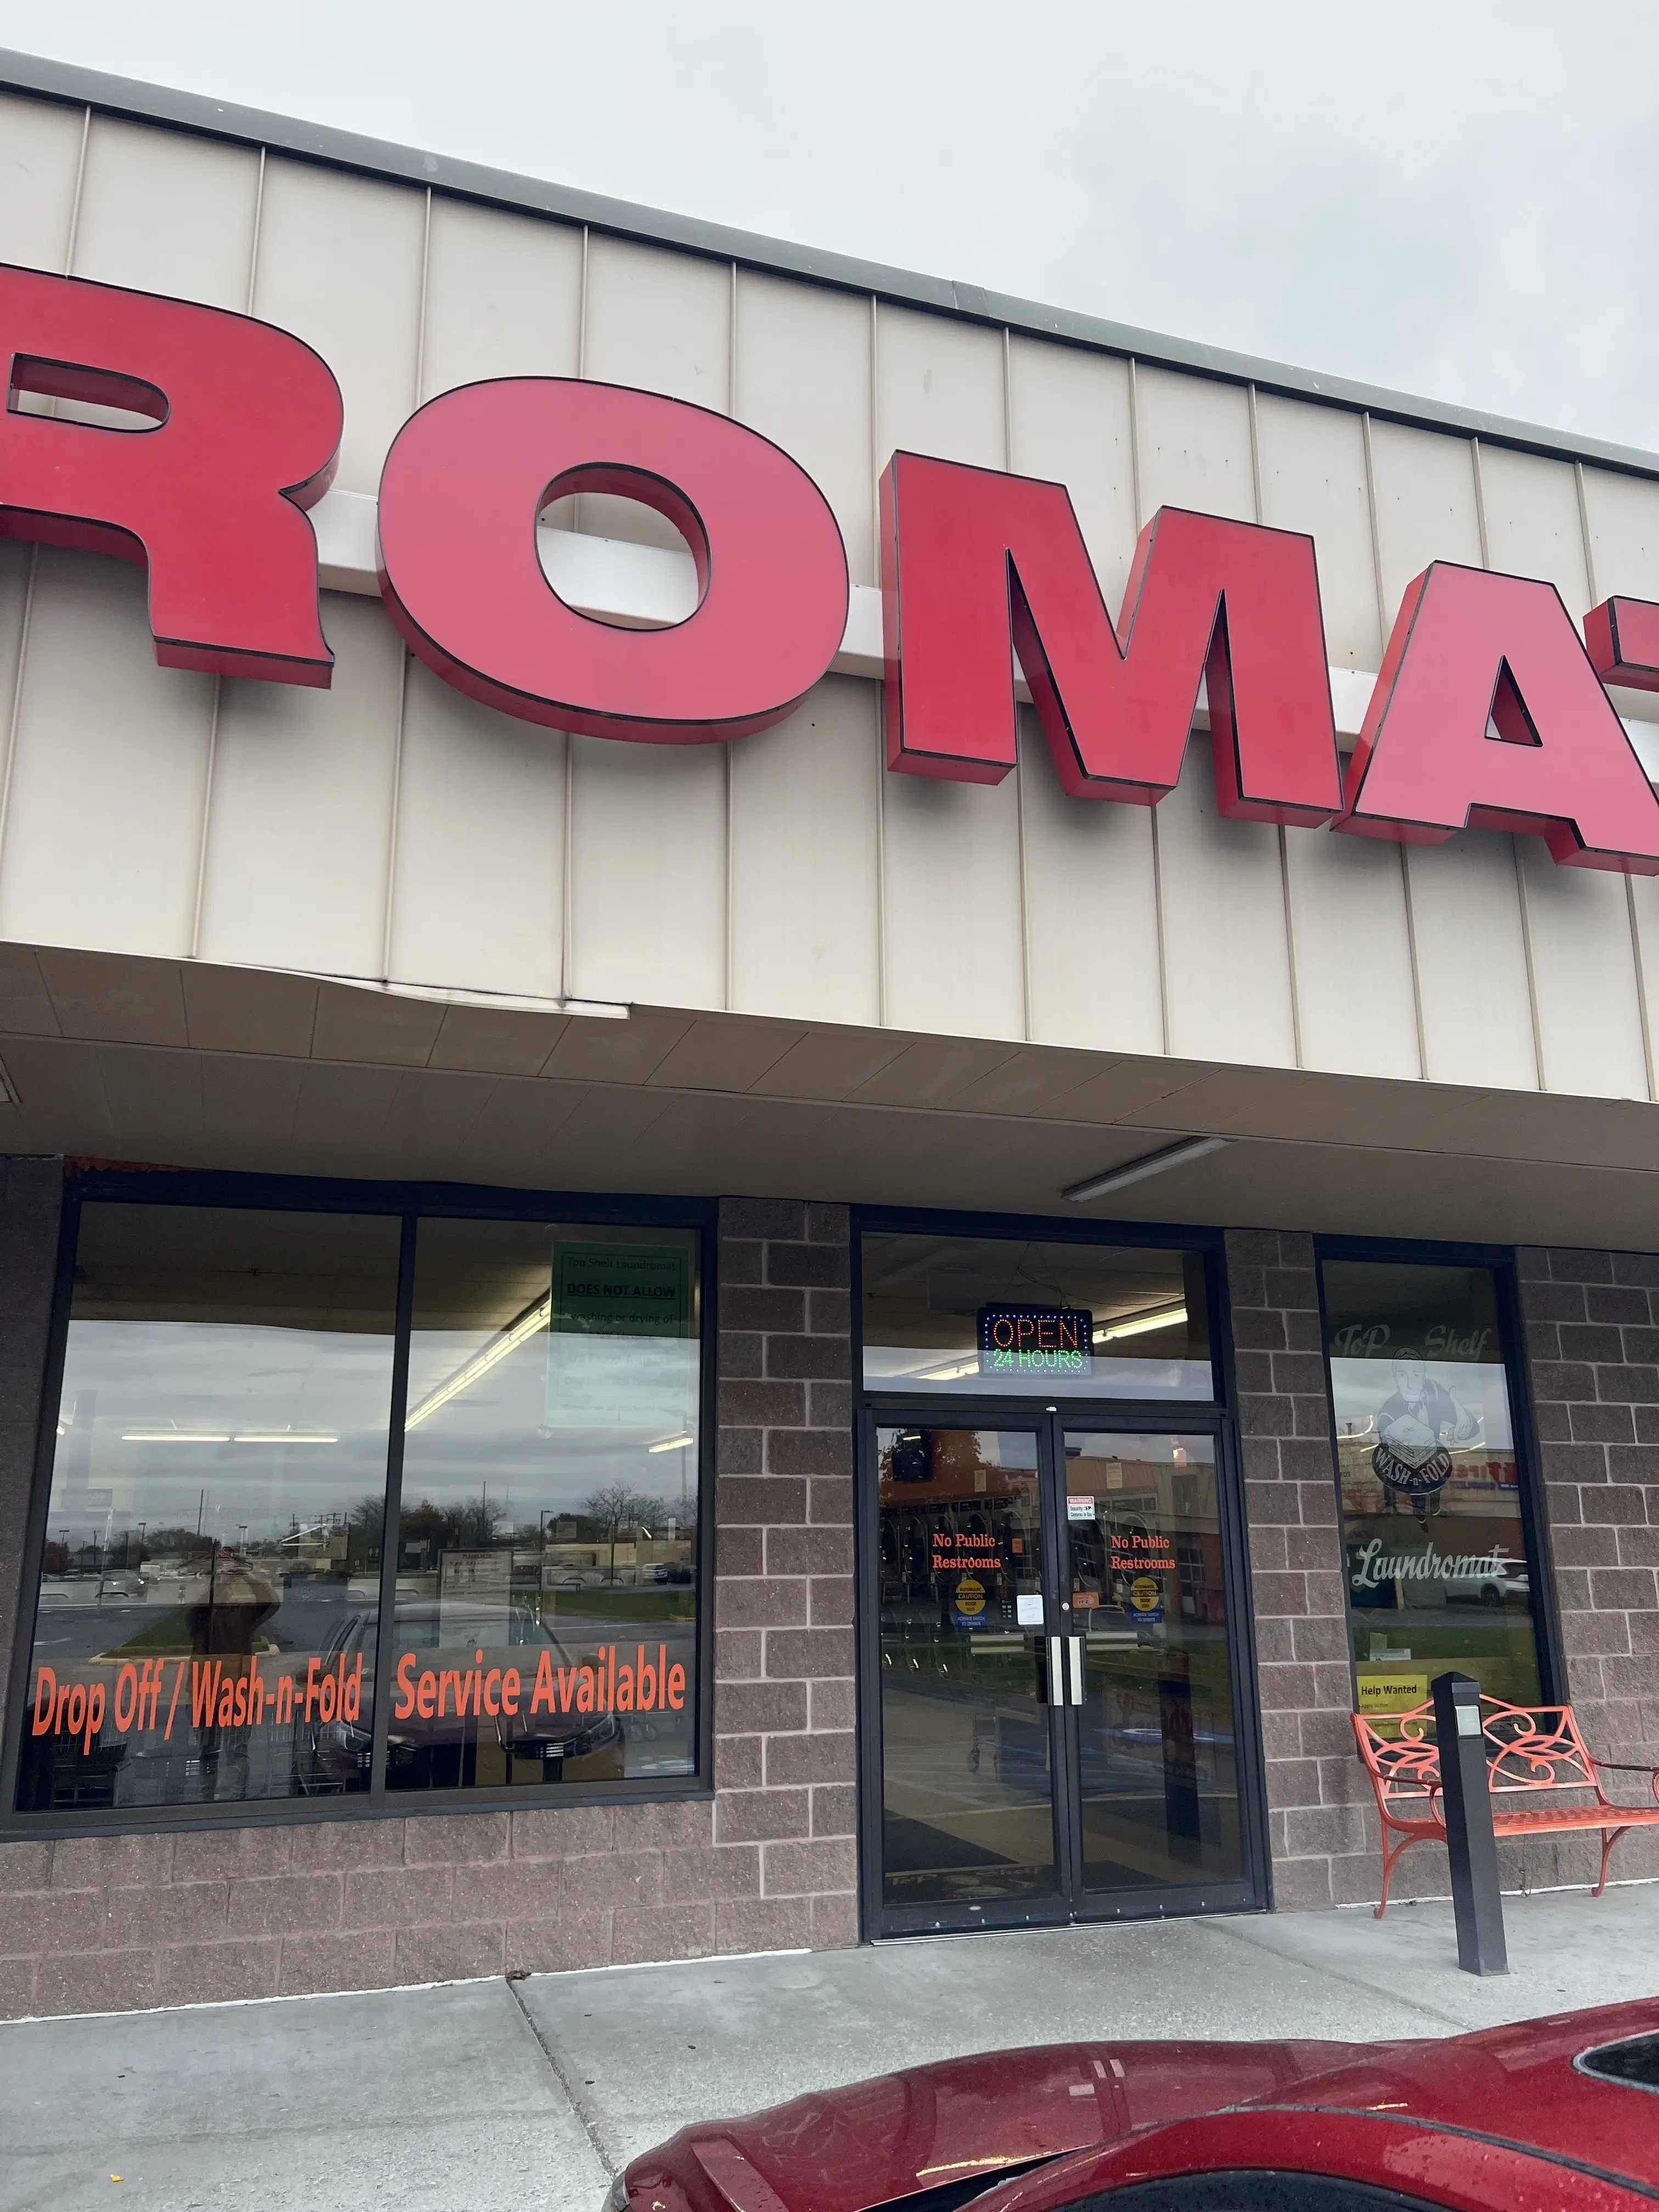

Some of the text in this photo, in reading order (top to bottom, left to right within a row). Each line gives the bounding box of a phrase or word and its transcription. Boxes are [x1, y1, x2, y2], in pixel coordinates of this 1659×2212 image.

[0, 265, 1659, 874] ROMA
[616, 1259, 676, 1271] Laundromat
[567, 1282, 676, 1298] DOES NOT ALLOW
[571, 1311, 675, 1327] washing or drying of
[994, 1319, 1078, 1348] OPEN
[1424, 1325, 1492, 1362] Shelf
[994, 1348, 1083, 1369] 24 HOURS
[933, 1533, 995, 1547] No Public
[1110, 1536, 1170, 1549] No Public
[932, 1555, 1001, 1568] Restrooms
[1110, 1556, 1175, 1569] Restrooms
[1352, 1538, 1509, 1588] Laundromat
[1361, 1685, 1417, 1697] Help Wanted
[32, 1644, 686, 1756] Drop Off / Wash-n-Fold Service Available
